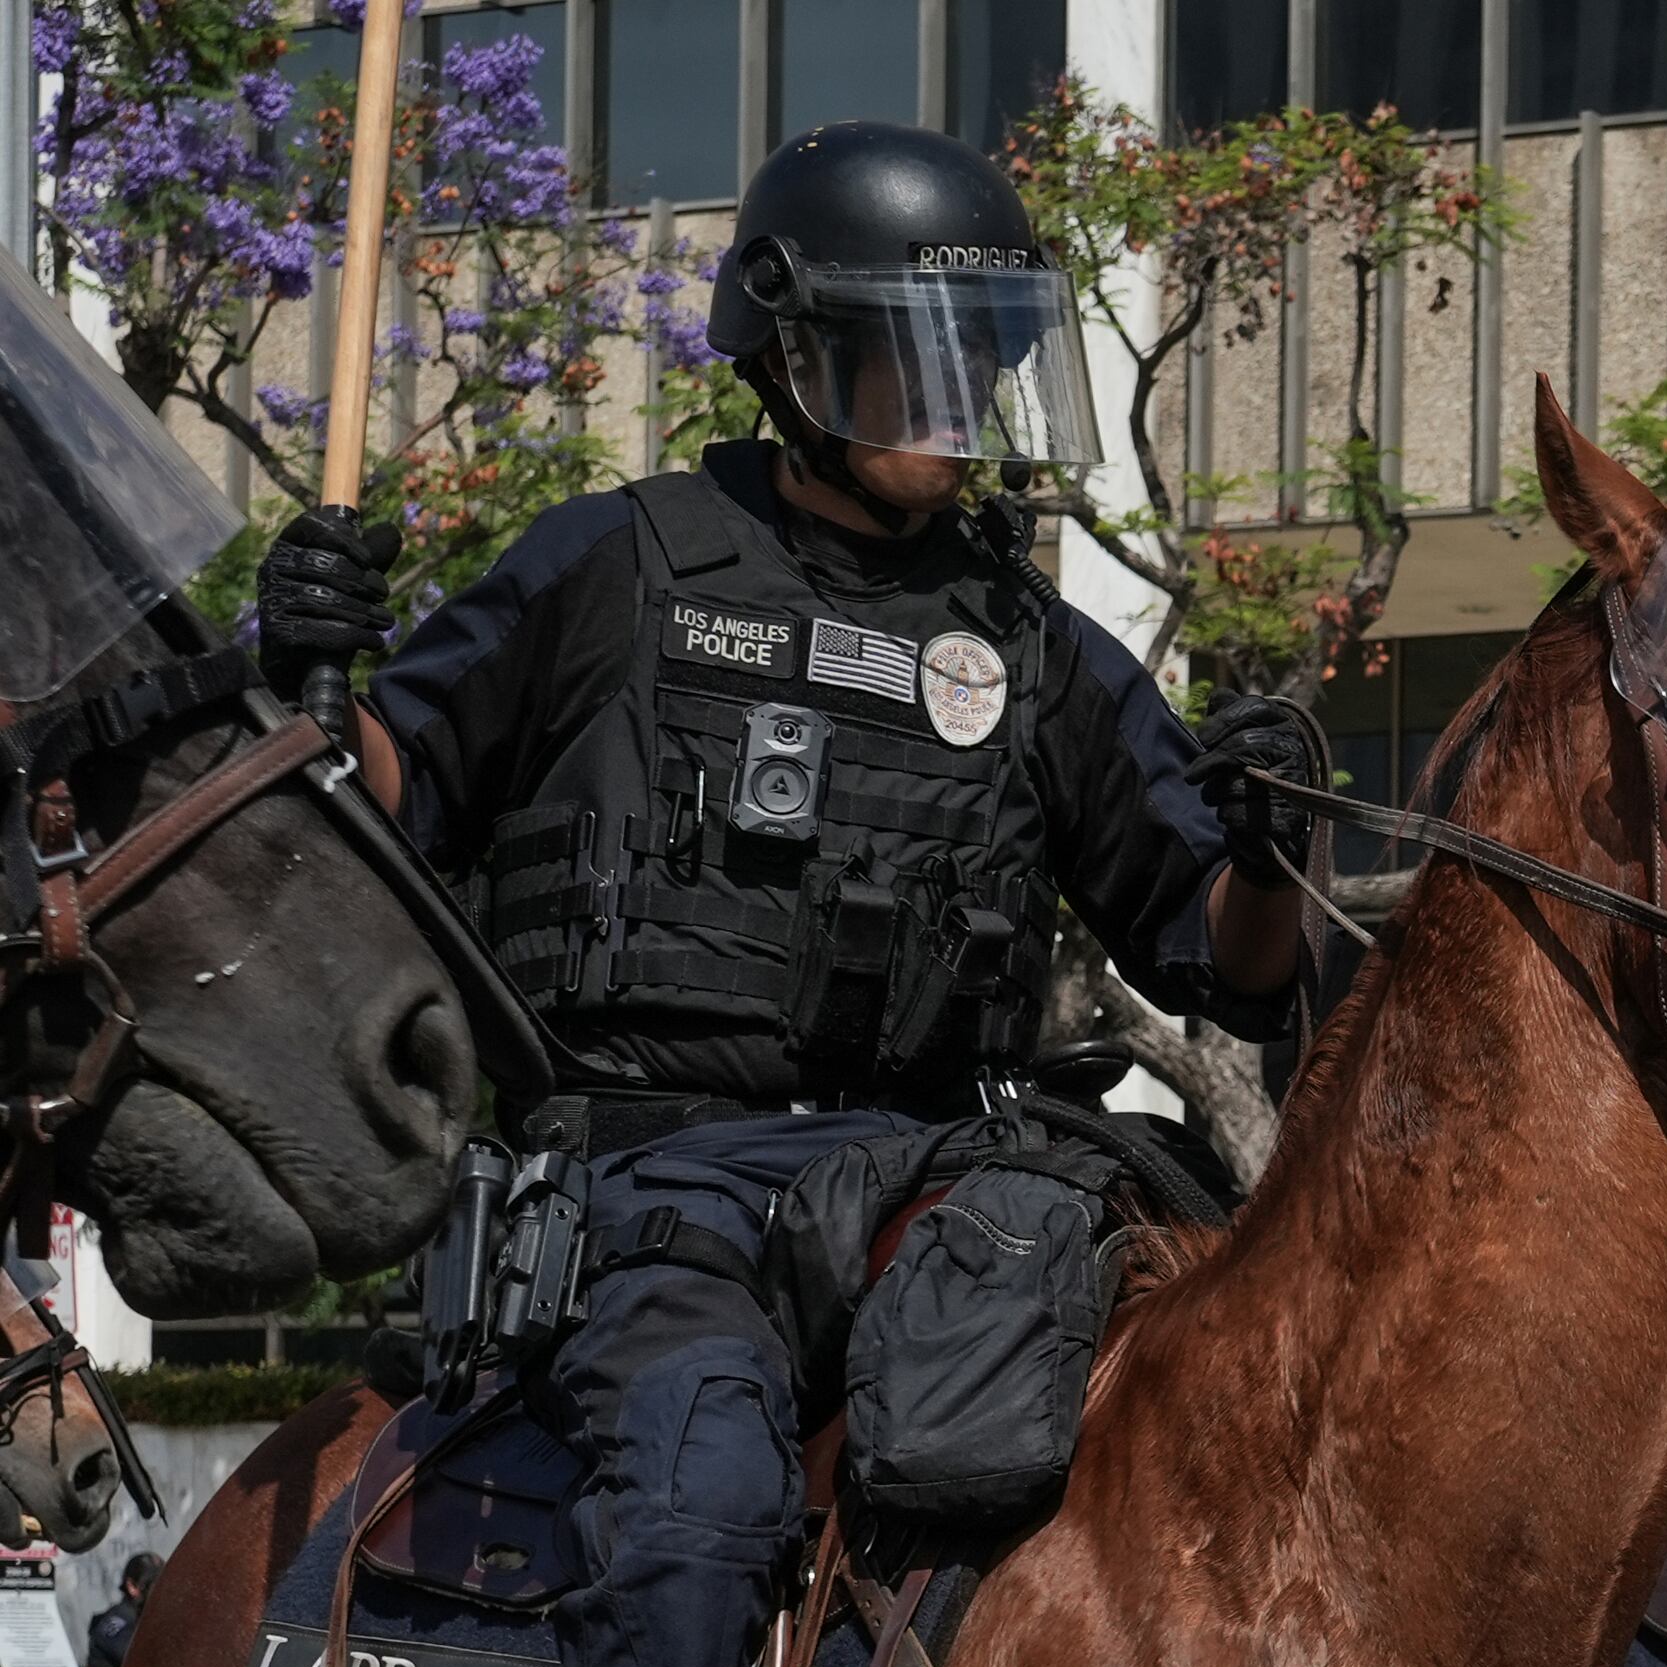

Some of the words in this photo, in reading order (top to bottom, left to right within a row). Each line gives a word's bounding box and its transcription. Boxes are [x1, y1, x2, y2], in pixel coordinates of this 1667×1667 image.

[674, 605, 708, 629] LOS
[712, 616, 790, 643] ANGELES
[686, 629, 773, 666] POLICE
[764, 825, 785, 835] AXON
